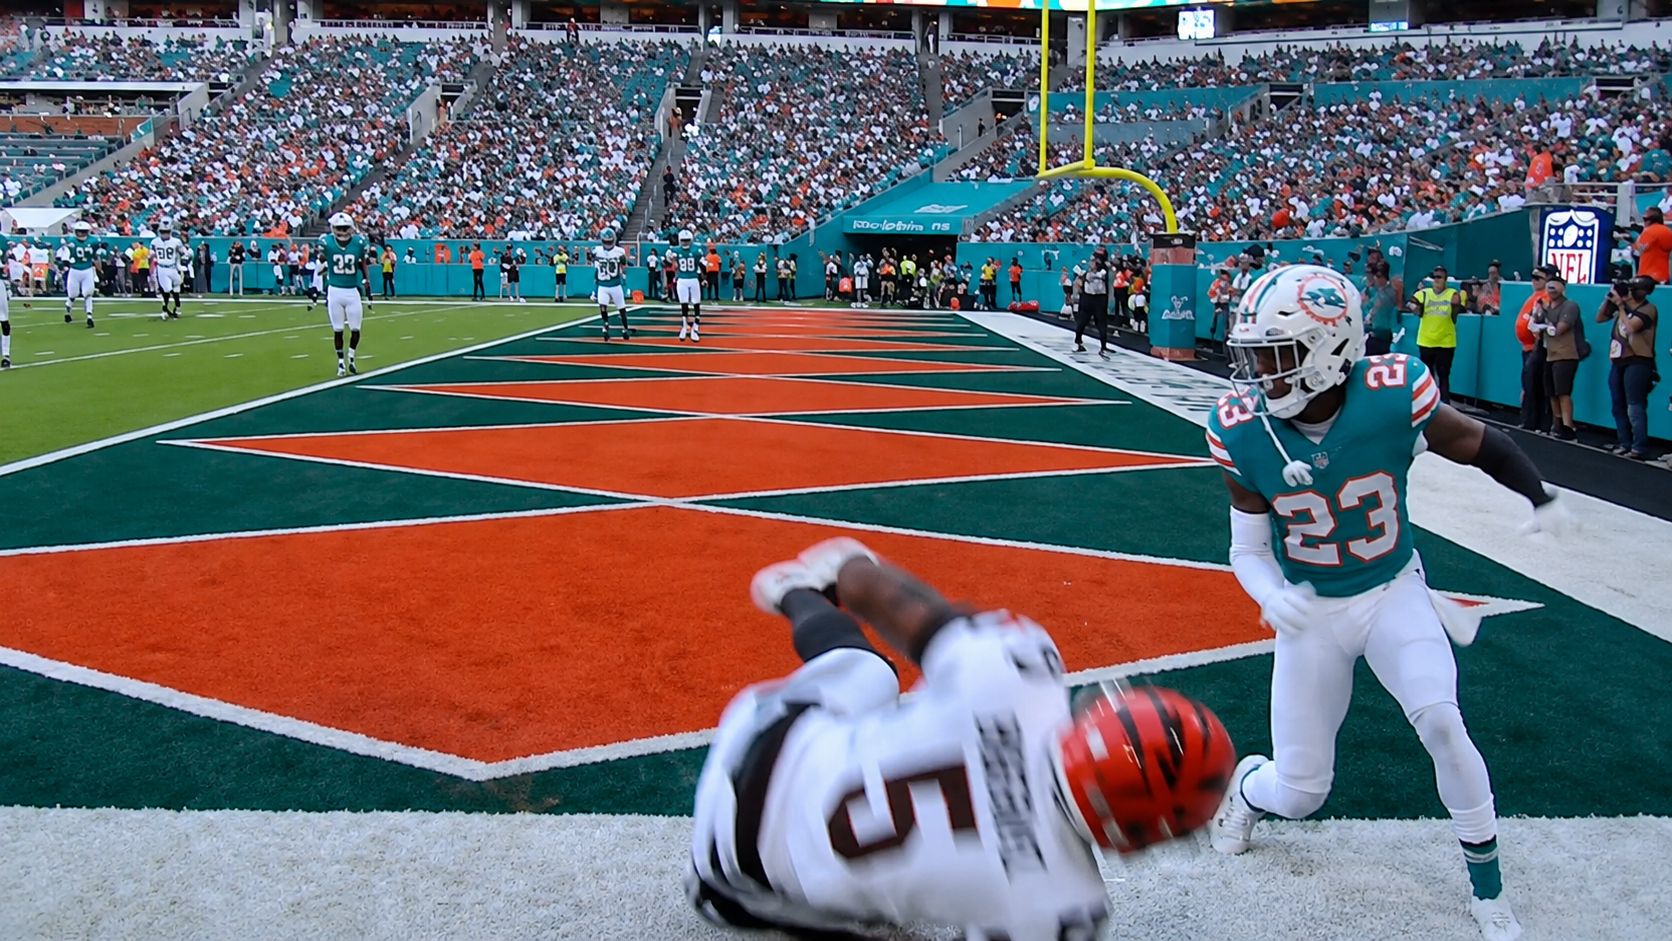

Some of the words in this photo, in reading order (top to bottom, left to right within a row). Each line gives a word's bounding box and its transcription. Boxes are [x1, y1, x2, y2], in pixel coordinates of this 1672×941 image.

[1551, 252, 1587, 284] NFL
[1270, 468, 1400, 567] 23
[828, 764, 978, 861] 5
